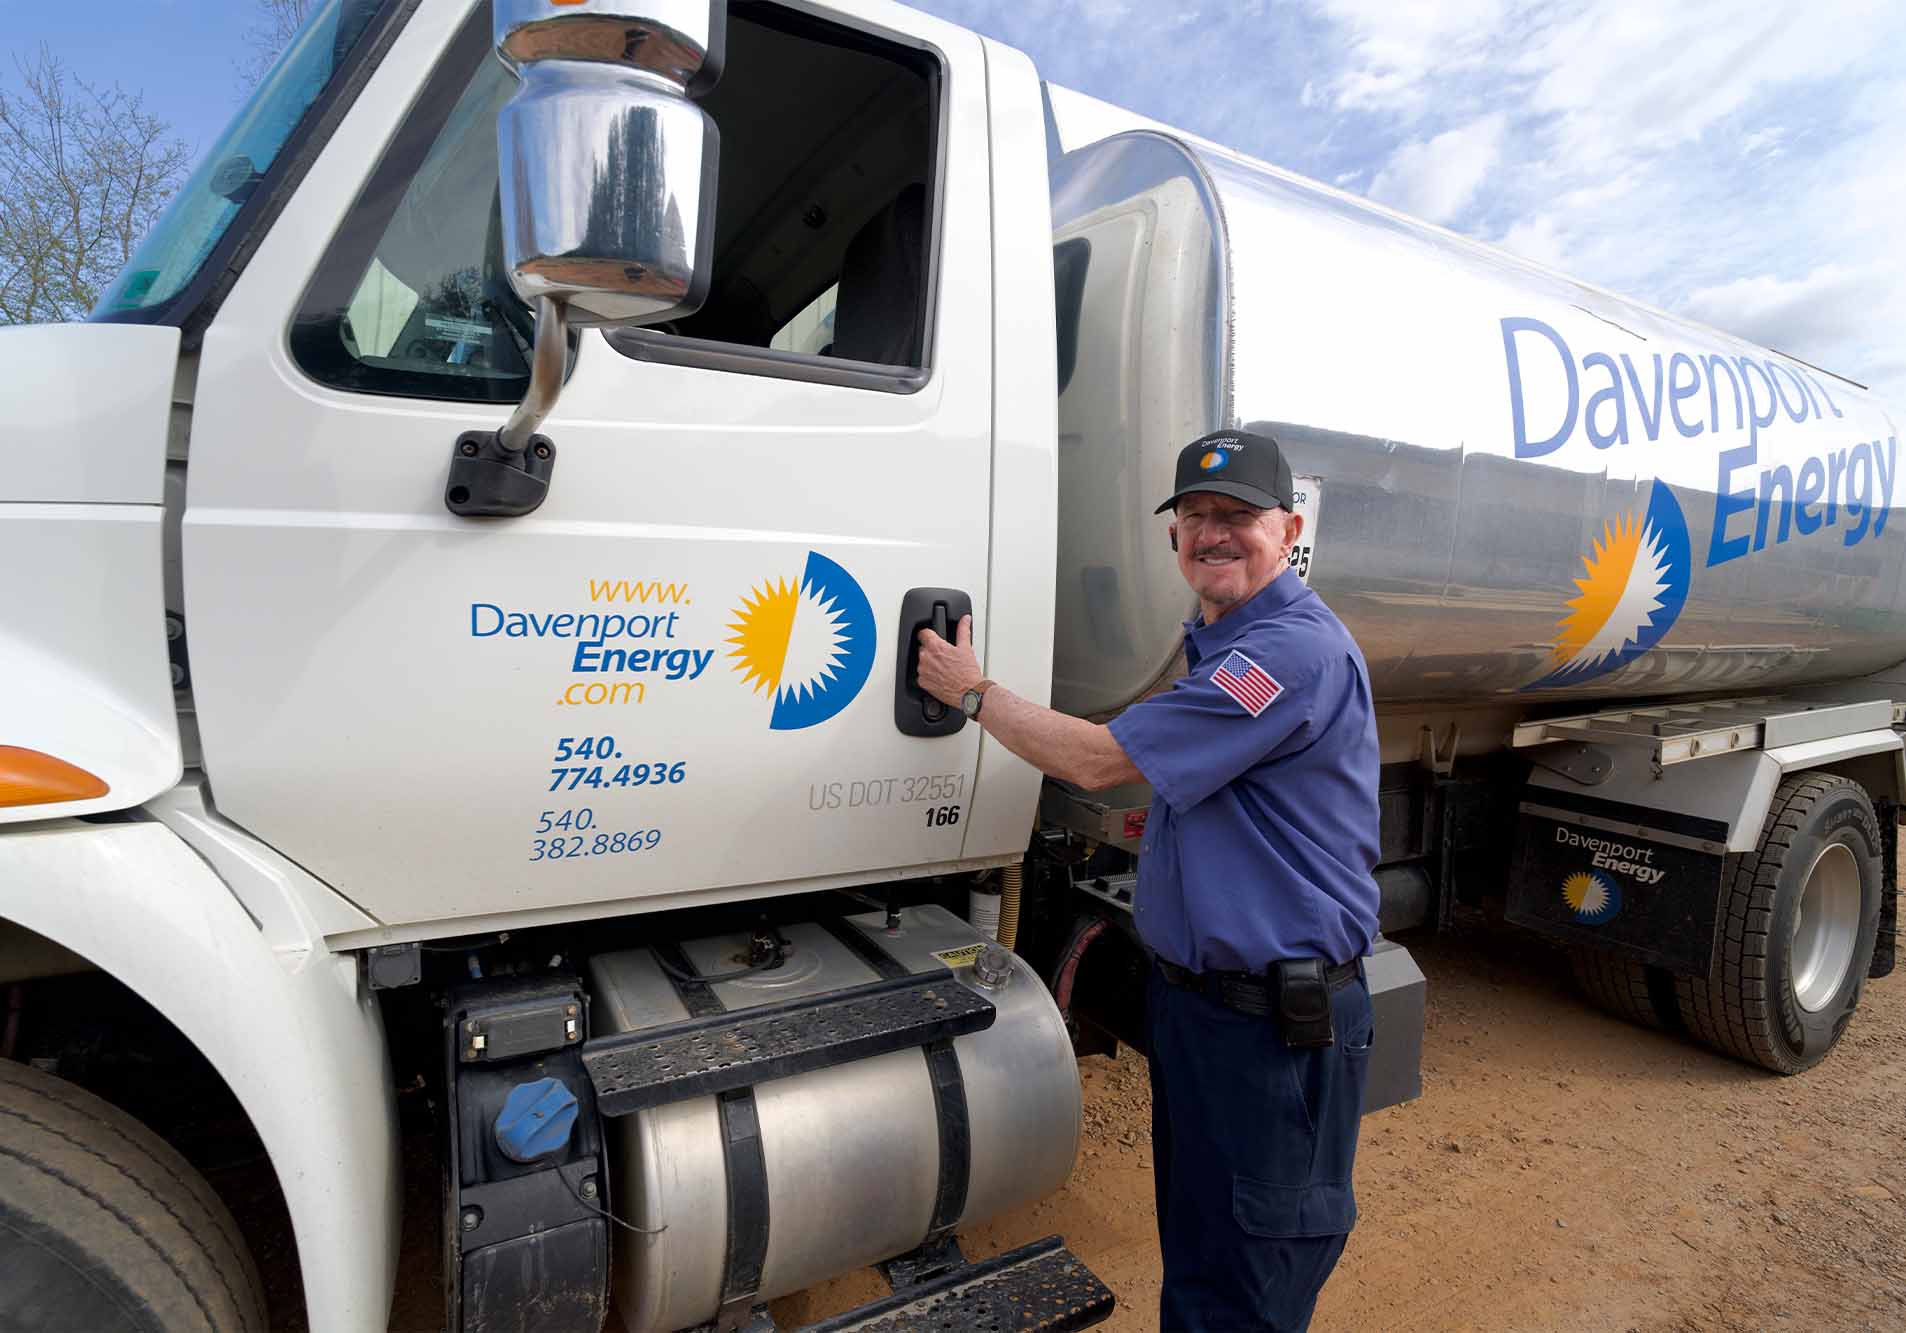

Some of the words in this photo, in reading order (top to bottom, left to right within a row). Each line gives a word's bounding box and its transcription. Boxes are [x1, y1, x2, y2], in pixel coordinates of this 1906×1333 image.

[1500, 316, 1844, 464] Davenport
[1201, 437, 1239, 448] Davenport
[1216, 441, 1245, 452] Energy
[1706, 436, 1897, 568] Energy
[1288, 545, 1311, 578] 25
[589, 578, 691, 605] www.
[471, 603, 680, 647] Davenport
[572, 641, 715, 681] Energy
[556, 680, 645, 706] .com
[554, 735, 623, 762] 540.
[548, 761, 687, 792] 774.4936
[809, 782, 842, 810] US
[848, 778, 899, 808] DOT
[902, 773, 965, 803] 32551
[535, 808, 597, 834] 540.
[925, 805, 961, 828] 166
[529, 828, 662, 862] 382.8869
[1555, 827, 1654, 864] Davenport
[1591, 853, 1667, 884] Energy
